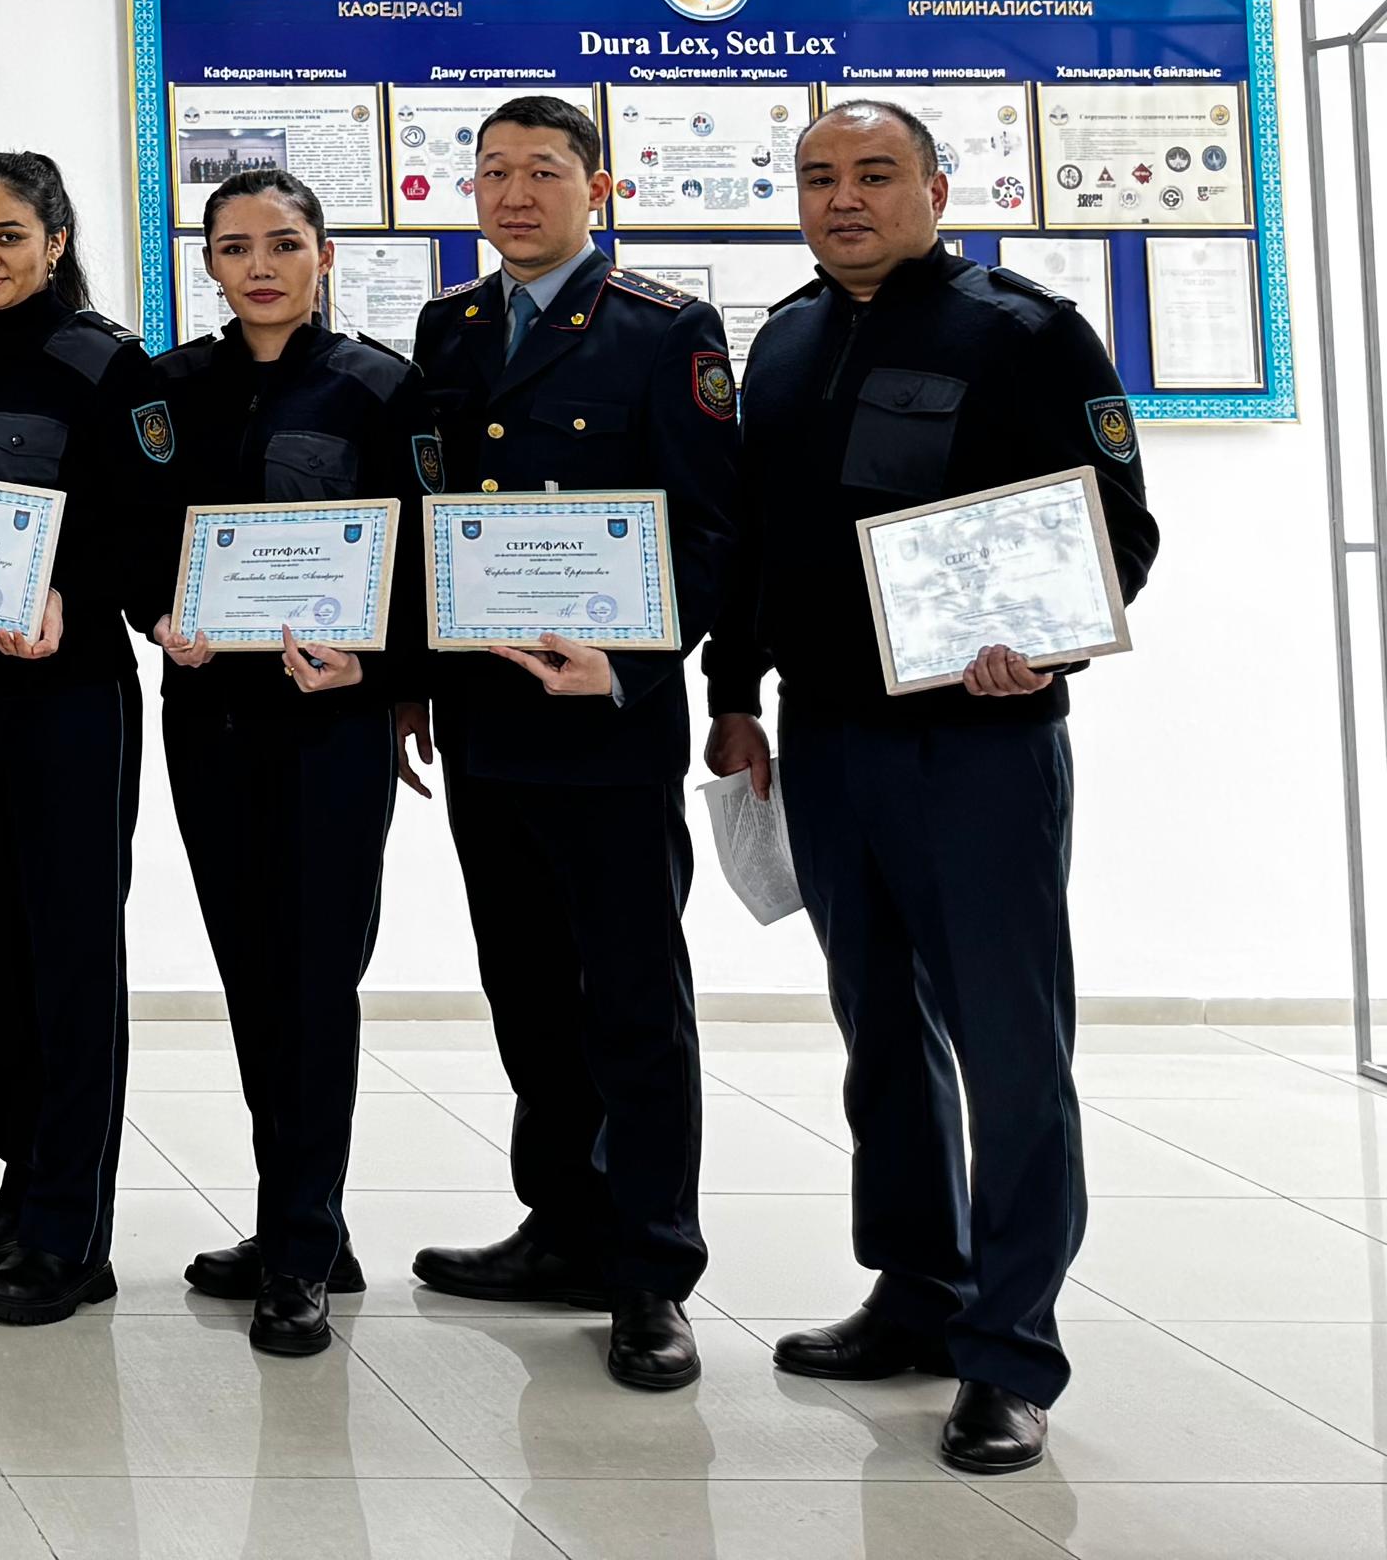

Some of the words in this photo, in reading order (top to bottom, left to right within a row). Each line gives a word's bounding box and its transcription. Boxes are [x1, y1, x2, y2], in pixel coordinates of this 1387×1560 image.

[339, 1, 462, 19] КАФЕДРАСЫ
[908, 1, 1093, 16] КРИМИНАЛИСТИКИ
[579, 32, 650, 54] Dura
[659, 32, 718, 59] Lex,
[727, 31, 776, 55] Sed
[784, 32, 835, 54] Lex
[204, 67, 293, 80] Кафедраның
[296, 69, 346, 80] тарихы
[431, 67, 466, 80] Даму
[470, 69, 556, 80] стратегиясы
[932, 69, 1005, 79] инновация
[1057, 66, 1151, 80] Халықаралық
[1153, 66, 1221, 77] байланыс
[252, 546, 321, 558] СЕРТИФИКАТ
[506, 540, 584, 552] СЕРТИФИКАТ
